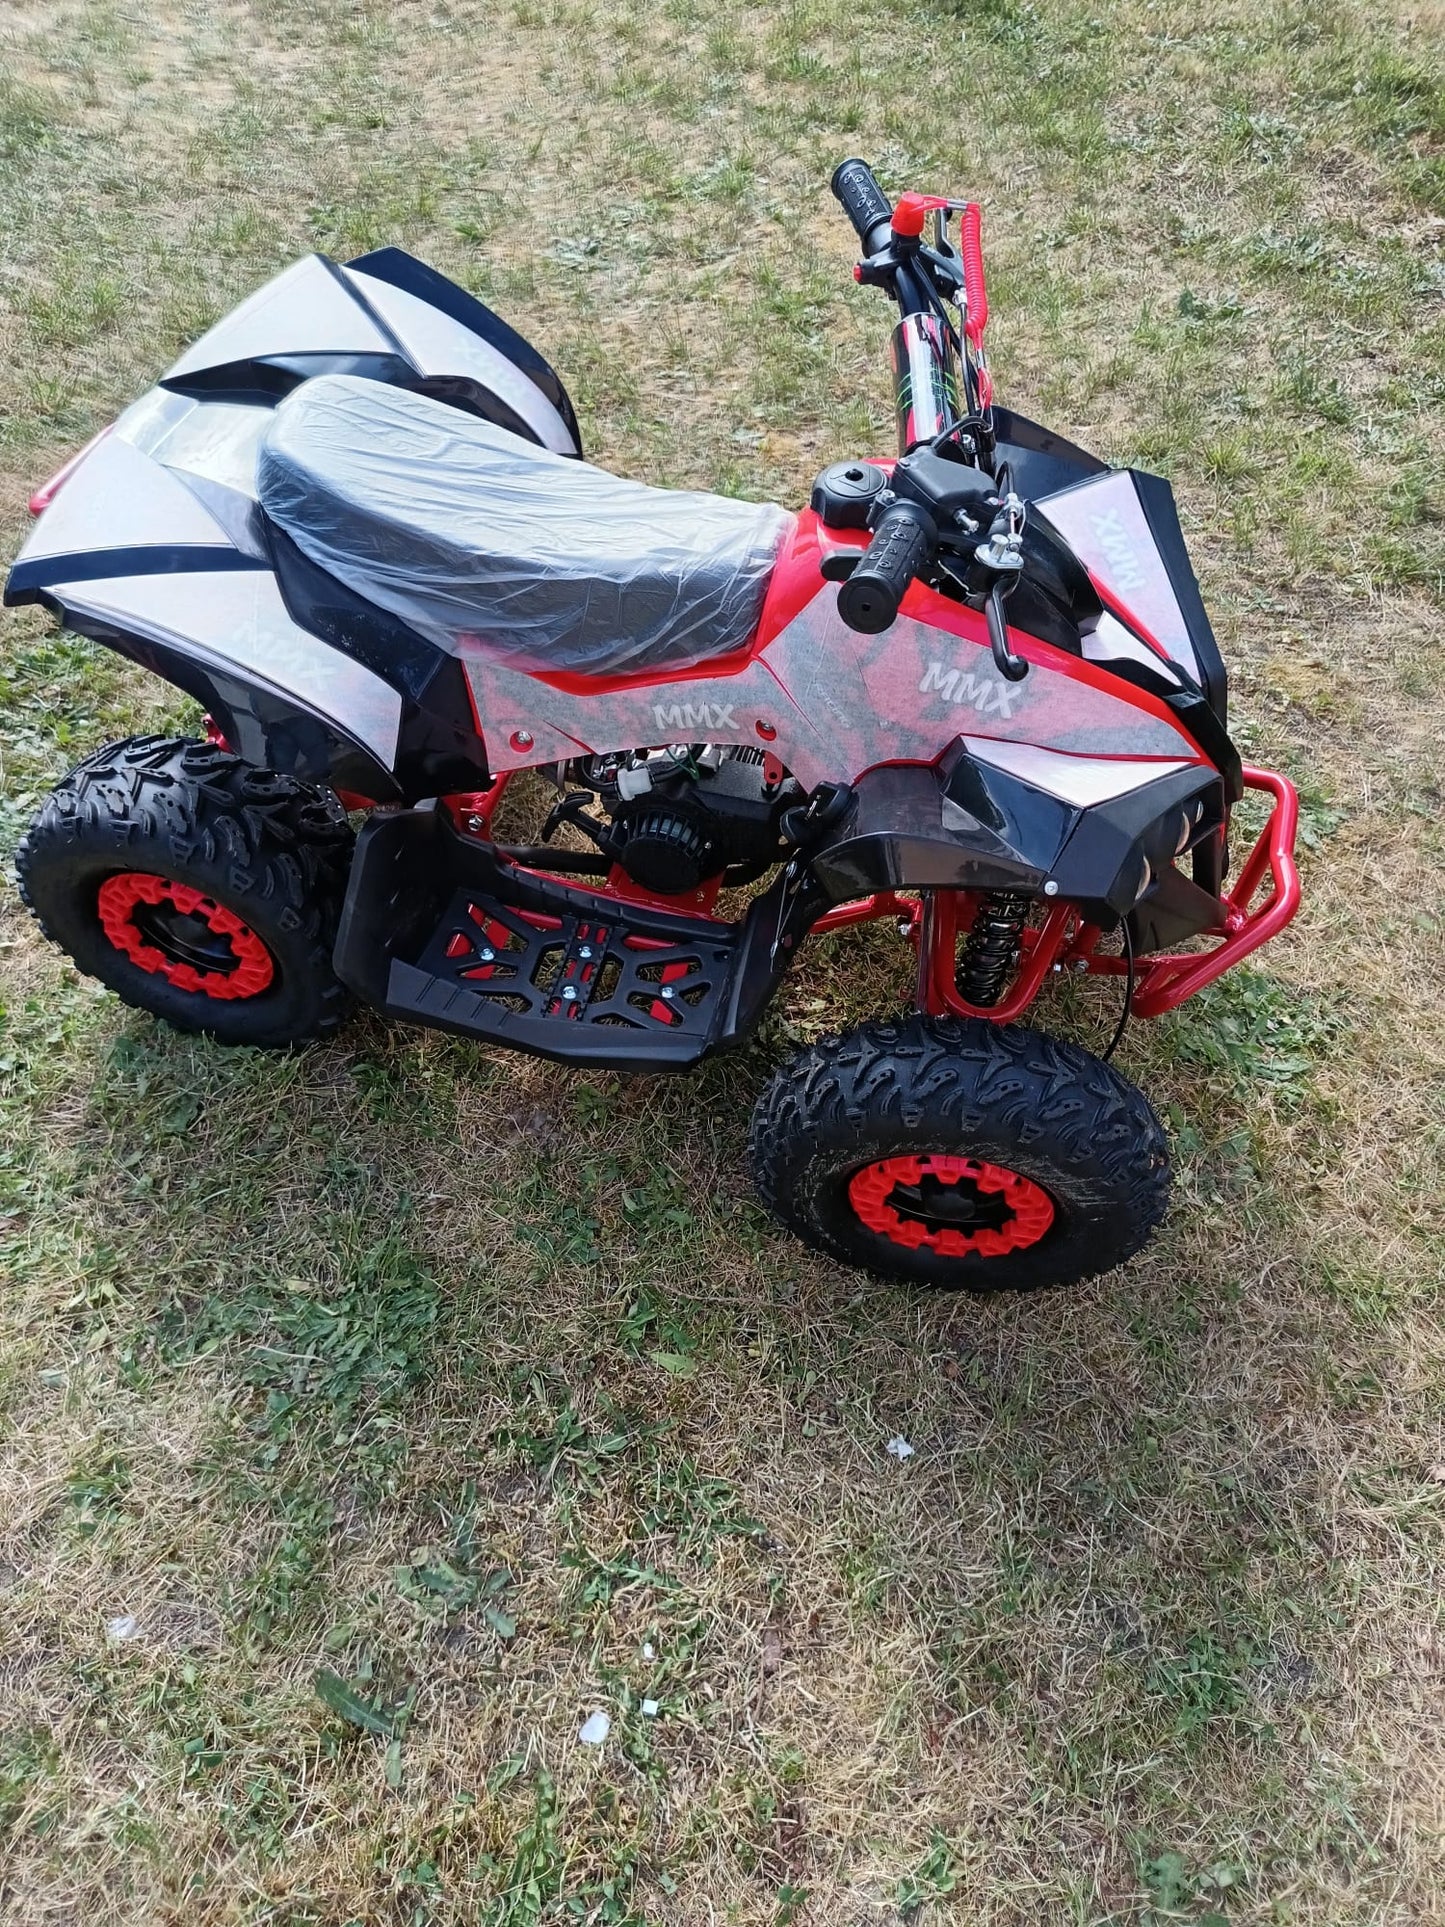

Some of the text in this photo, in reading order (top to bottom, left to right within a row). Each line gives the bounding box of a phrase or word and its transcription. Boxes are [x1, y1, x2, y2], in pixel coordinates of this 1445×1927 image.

[1088, 508, 1147, 592] MMX
[652, 704, 740, 729] MMX
[919, 662, 1022, 719] MMX
